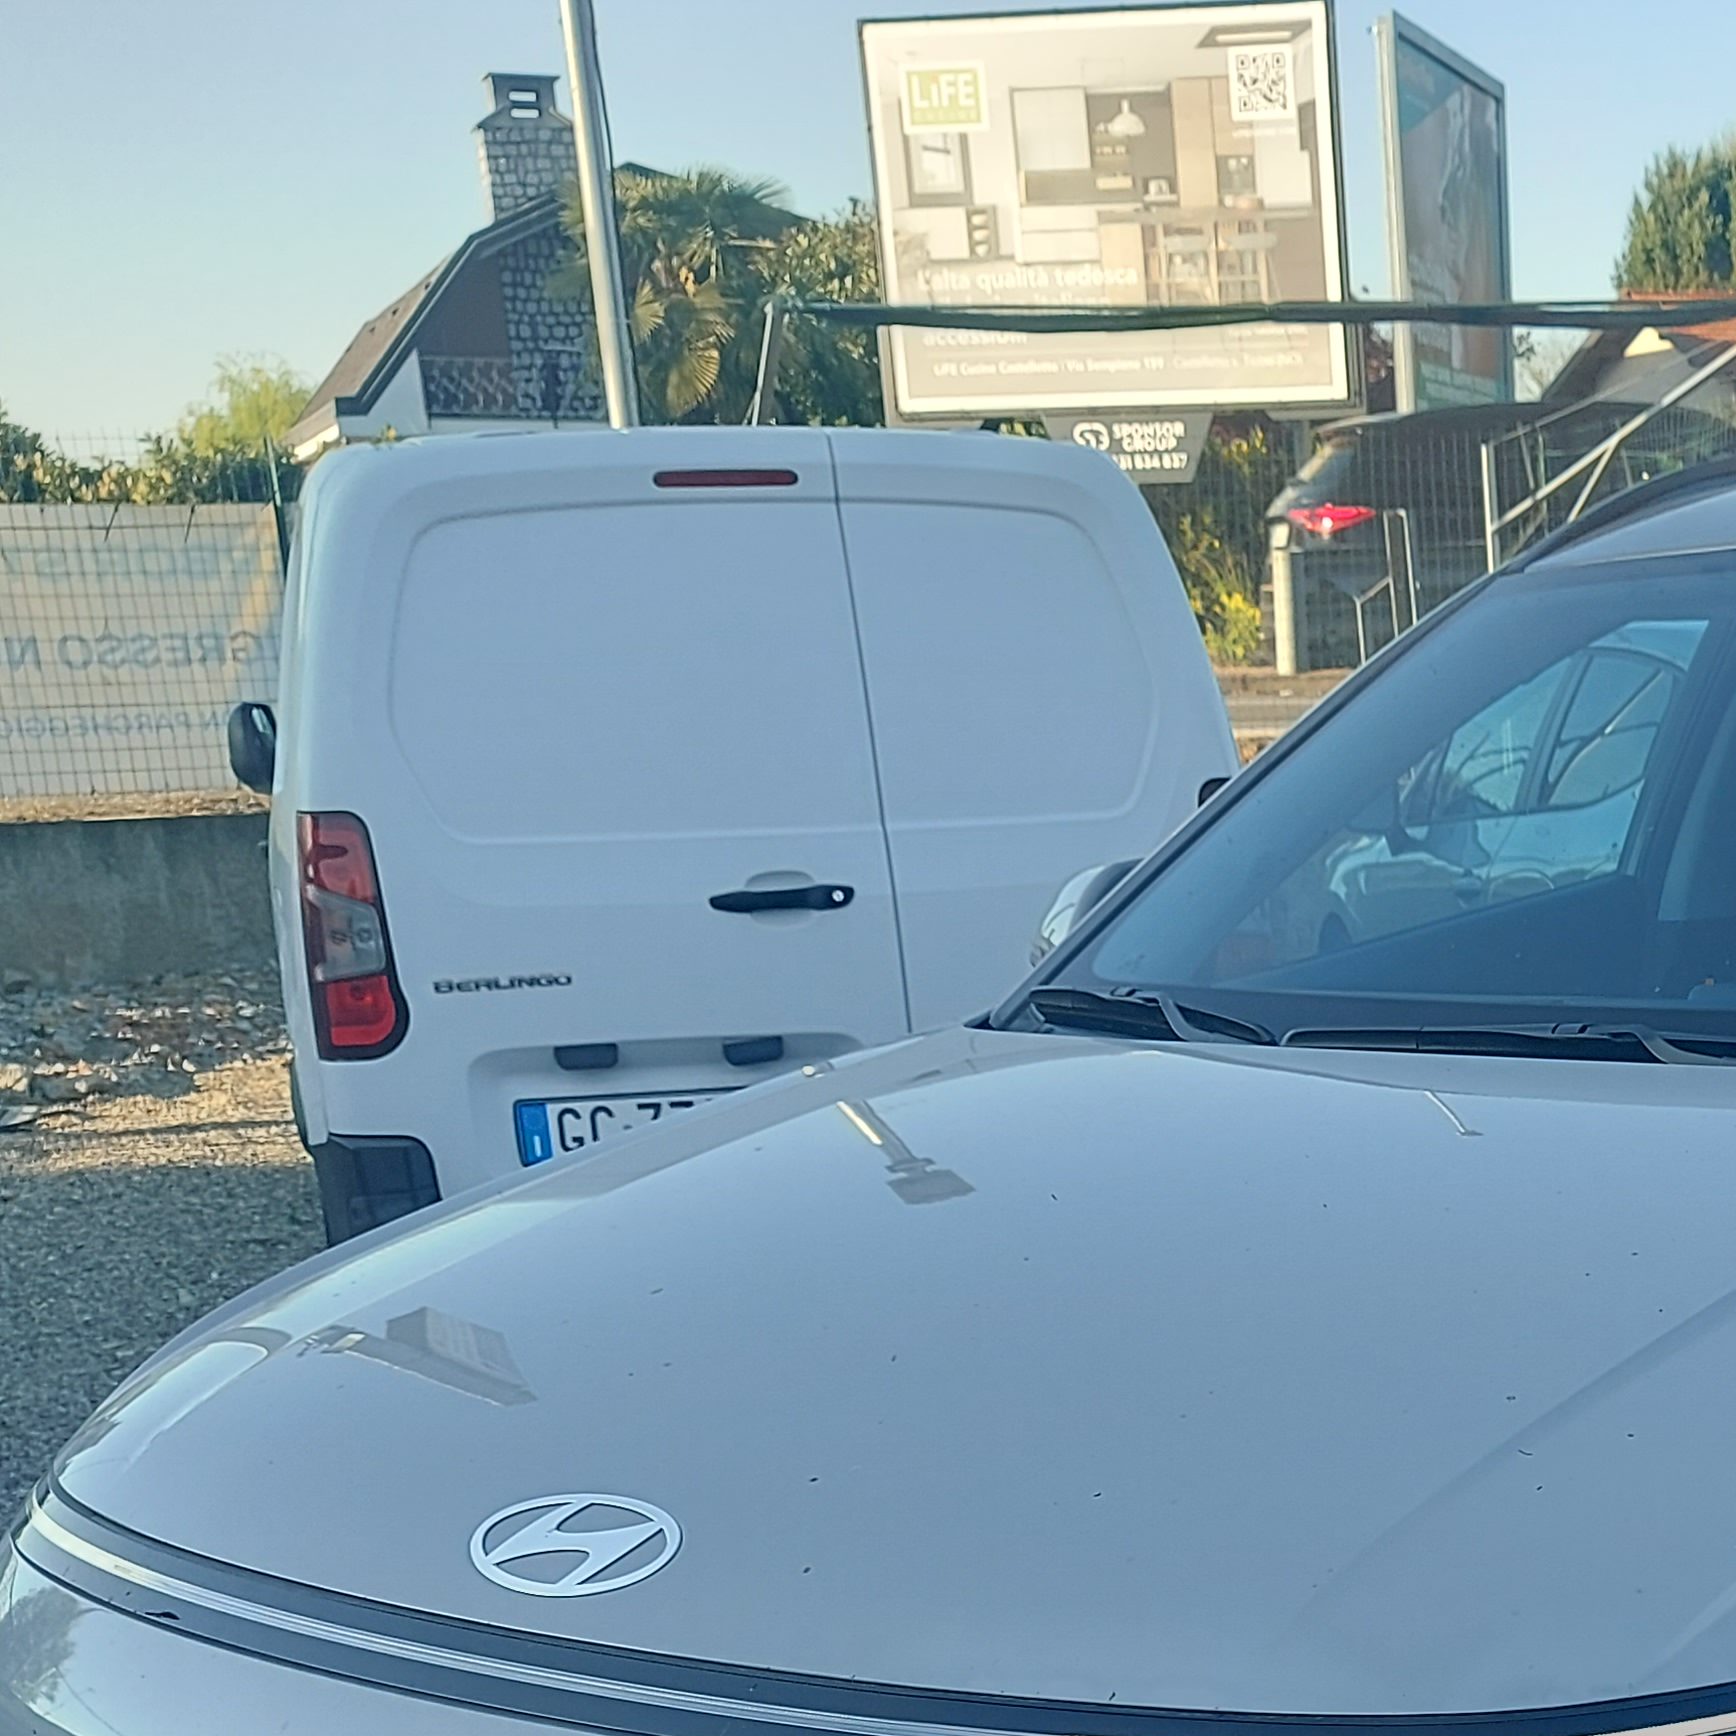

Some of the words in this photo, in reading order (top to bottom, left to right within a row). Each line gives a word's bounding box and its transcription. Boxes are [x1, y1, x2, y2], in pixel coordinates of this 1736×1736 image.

[910, 72, 976, 109] LiFE
[975, 265, 1050, 297] qualità
[1053, 263, 1138, 289] tedesca
[433, 974, 573, 994] BERLINGO
